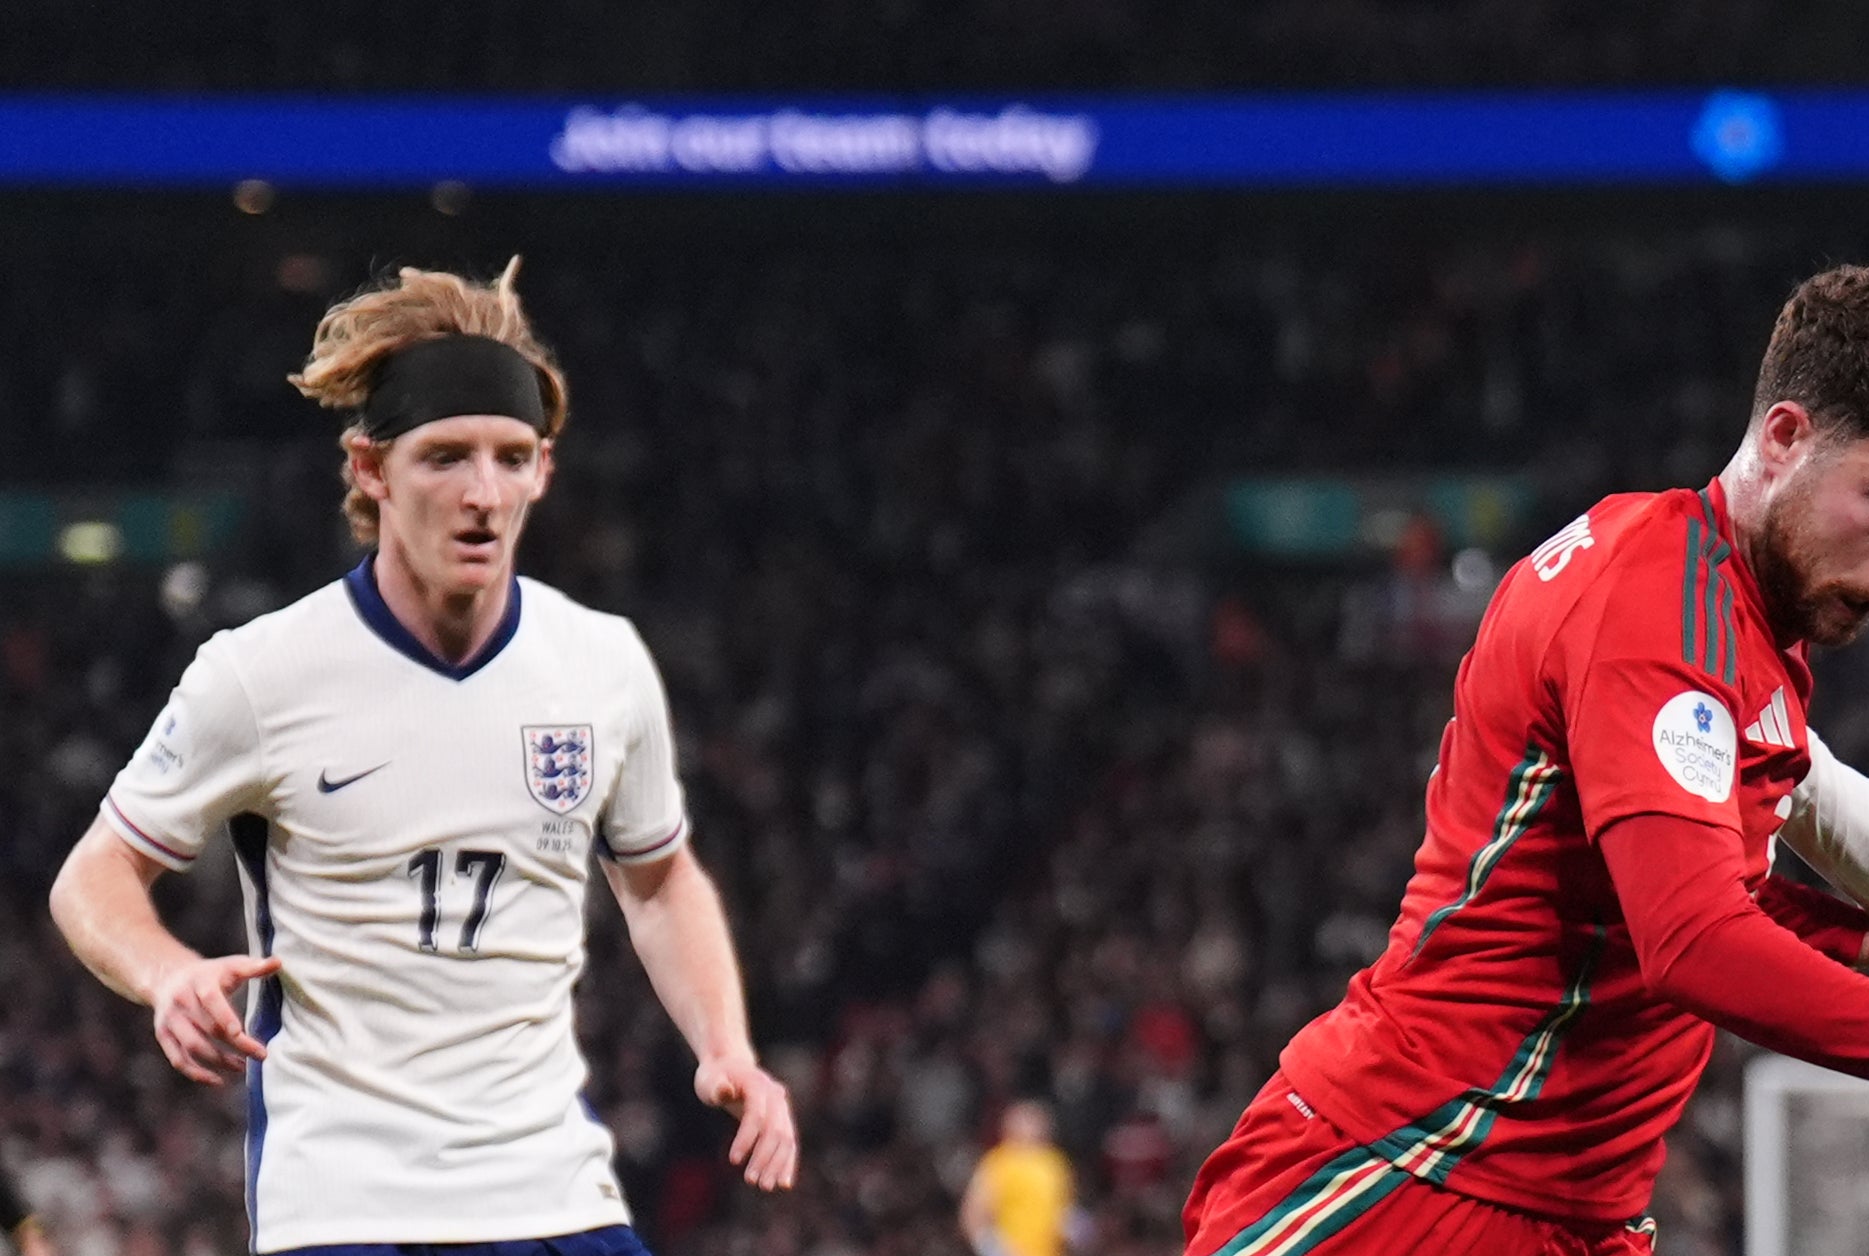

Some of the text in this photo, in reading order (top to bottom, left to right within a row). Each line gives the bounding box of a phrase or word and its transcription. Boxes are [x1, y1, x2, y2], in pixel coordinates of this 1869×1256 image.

[922, 104, 1098, 181] today
[1660, 729, 1731, 766] Alzheimer's
[1675, 748, 1722, 782] Society
[406, 848, 506, 953] 17
